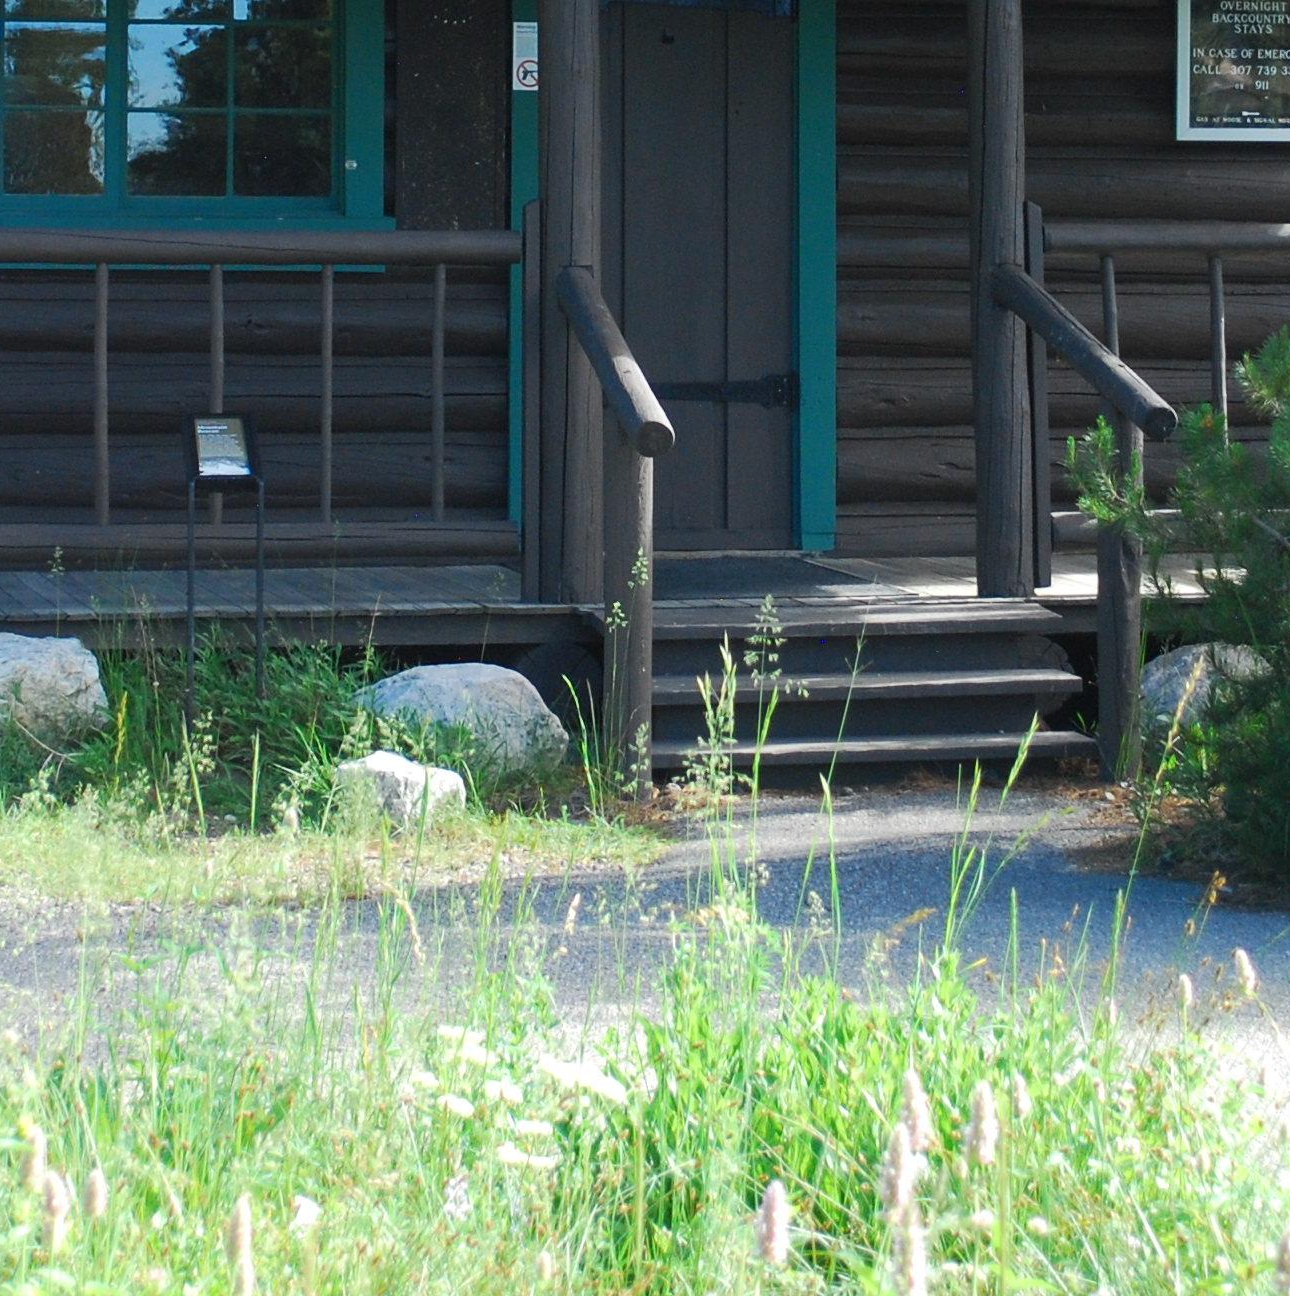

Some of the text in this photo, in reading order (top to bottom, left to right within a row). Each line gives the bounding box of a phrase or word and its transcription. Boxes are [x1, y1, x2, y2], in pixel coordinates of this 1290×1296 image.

[1219, 0, 1288, 13] OVERNIGHT
[1233, 24, 1274, 35] STAYS
[1192, 47, 1205, 58] IN
[1208, 48, 1238, 59] CASE
[1240, 48, 1255, 60] OF
[1192, 64, 1221, 75] CALL
[1229, 64, 1253, 76] 307
[1257, 65, 1278, 76] 739
[1254, 80, 1270, 91] 911
